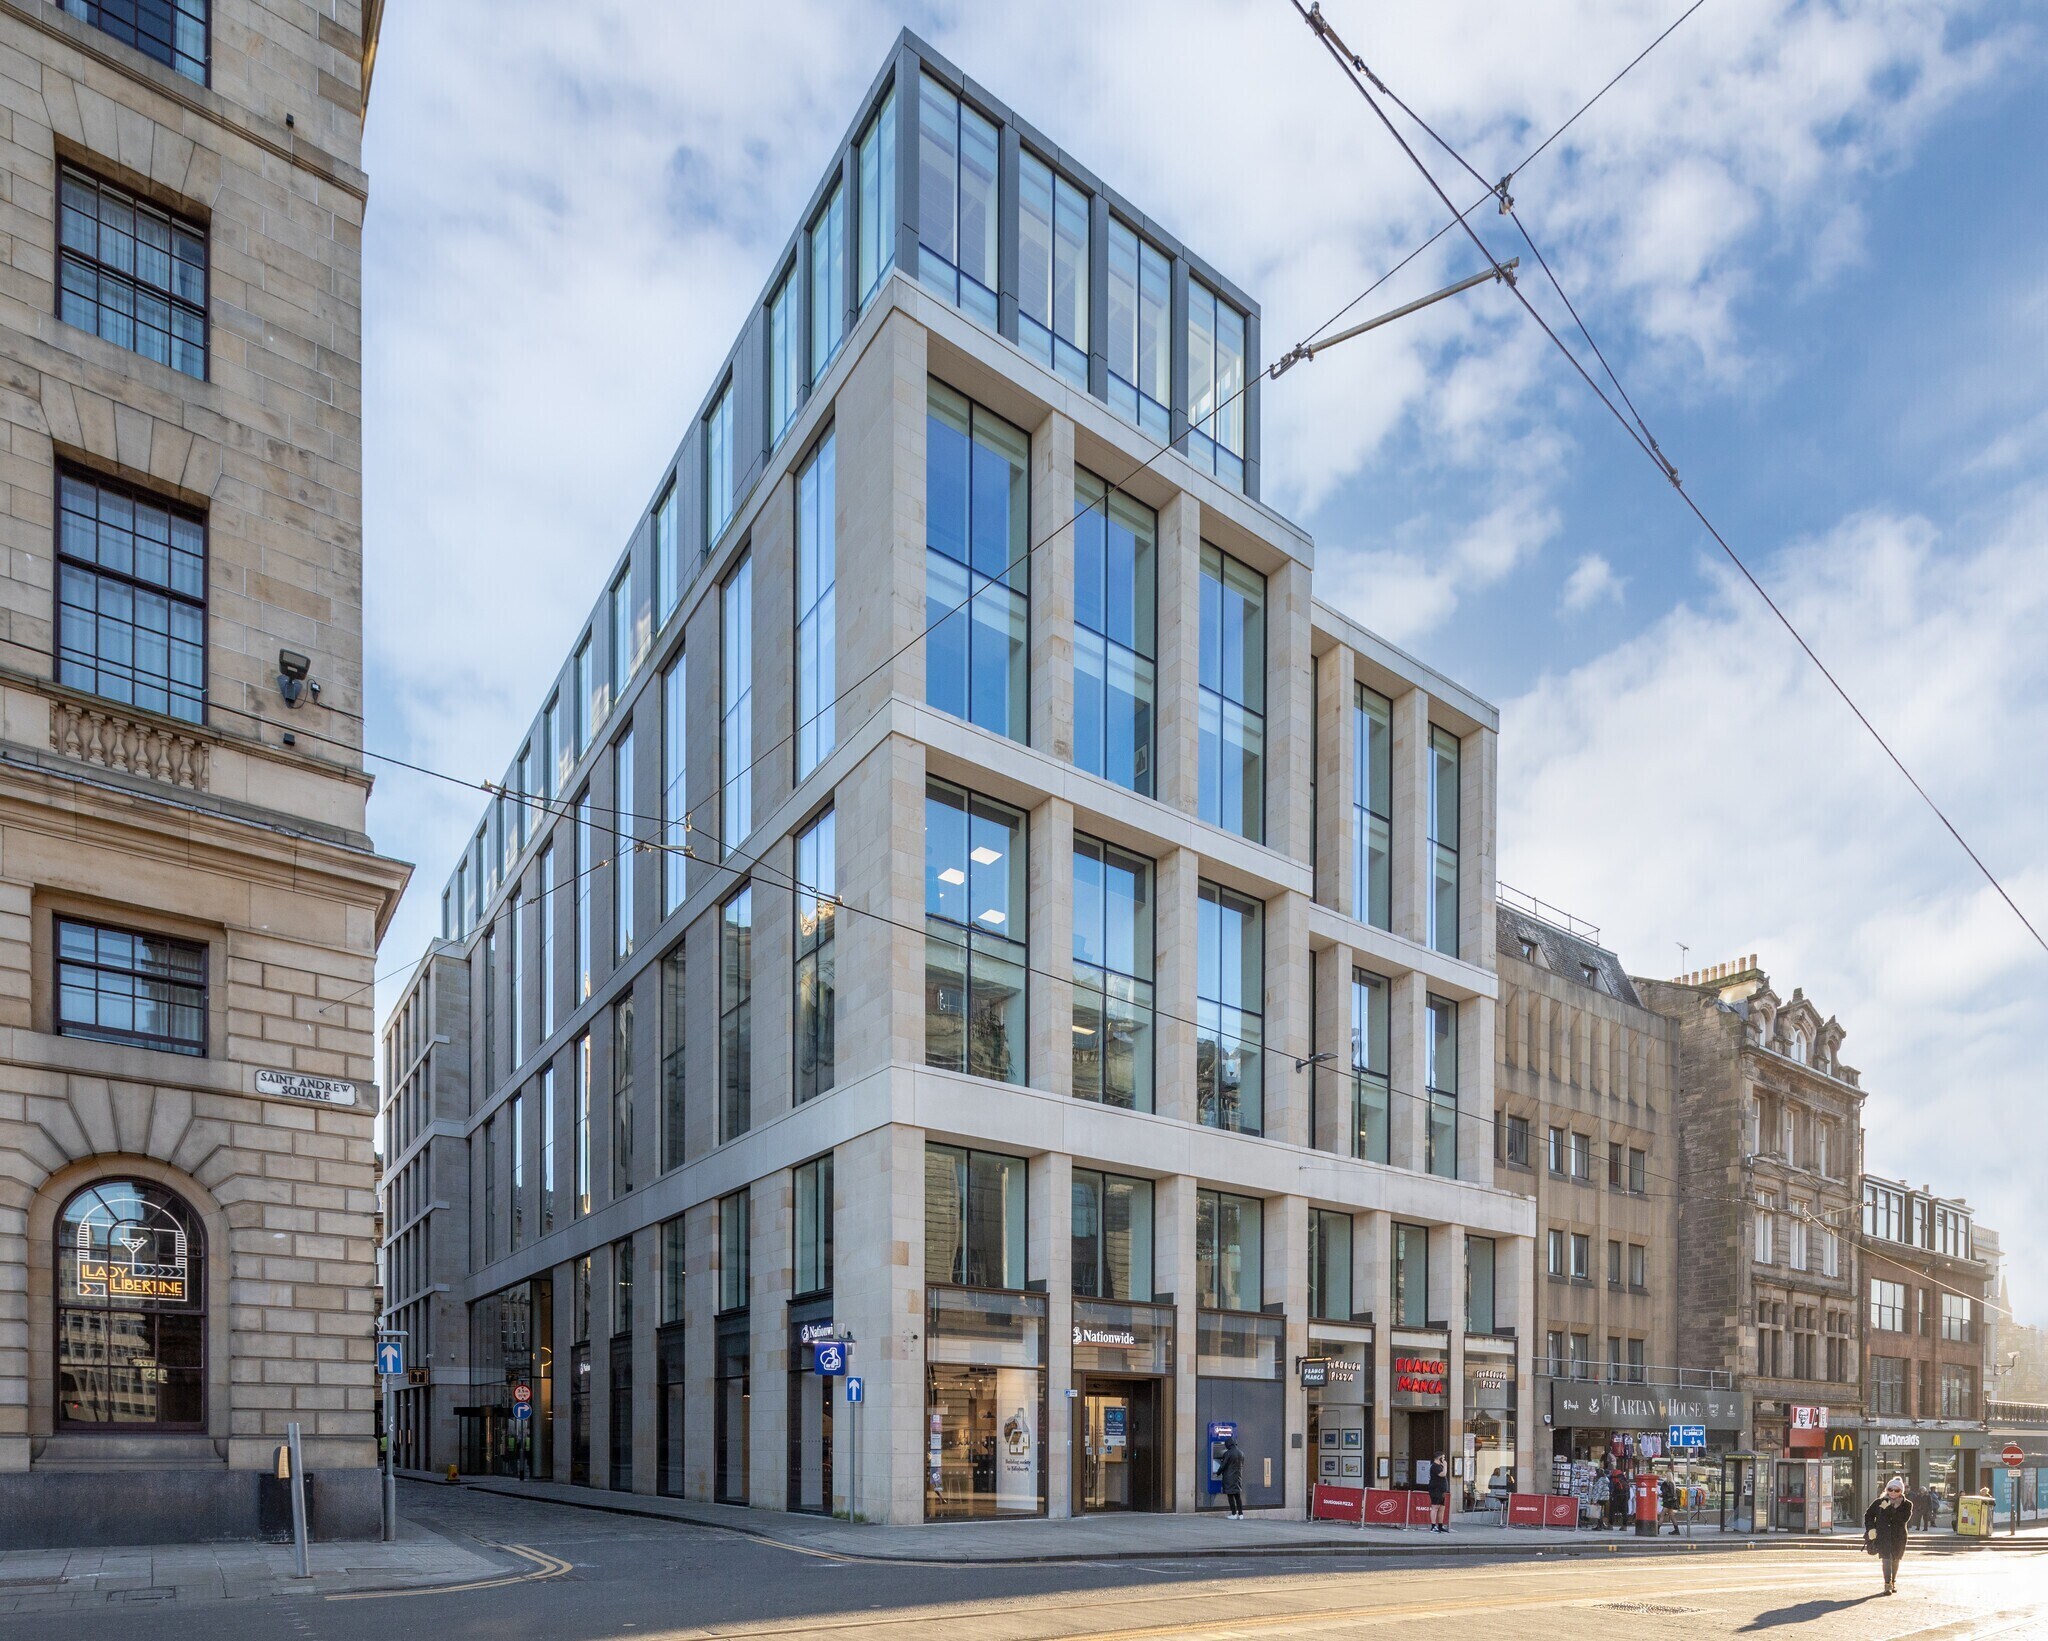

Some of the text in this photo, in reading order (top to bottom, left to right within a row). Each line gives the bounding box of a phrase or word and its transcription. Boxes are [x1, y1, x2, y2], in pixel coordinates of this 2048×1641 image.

[260, 1072, 350, 1092] SAINT ANDREW
[281, 1085, 331, 1100] SQUARE
[1083, 1329, 1135, 1345] Nationwide
[1396, 1358, 1445, 1375] FRANCO
[1476, 1369, 1507, 1380] SOURDOUGH
[1397, 1376, 1443, 1395] MANCA
[1612, 1395, 1656, 1416] TARTAN
[1668, 1398, 1702, 1417] HOUSE
[1879, 1433, 1920, 1446] McDonald's
